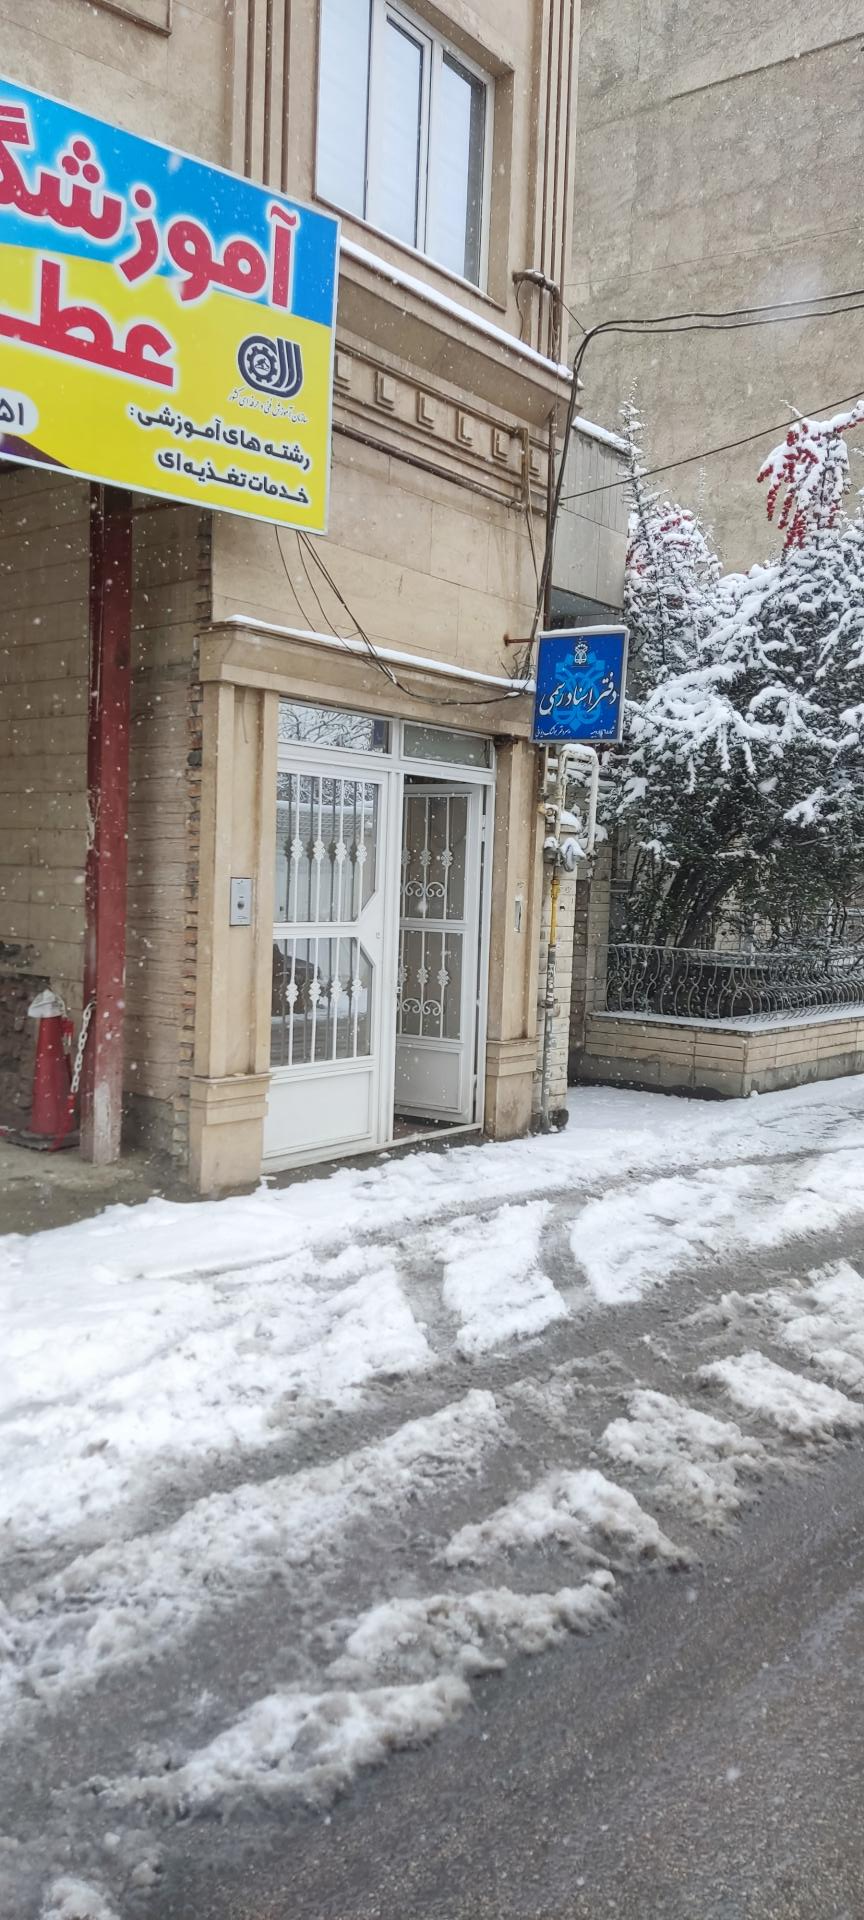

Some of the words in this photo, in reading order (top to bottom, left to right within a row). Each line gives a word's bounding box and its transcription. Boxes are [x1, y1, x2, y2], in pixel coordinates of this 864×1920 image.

[0, 106, 297, 308] آموزشگ
[0, 259, 173, 387] عط
[223, 428, 261, 452] های
[264, 443, 310, 471] رشته
[248, 476, 309, 504] خدمات
[539, 682, 566, 716] رسمی
[565, 685, 594, 706] اسناد
[587, 671, 617, 713] دفتر
